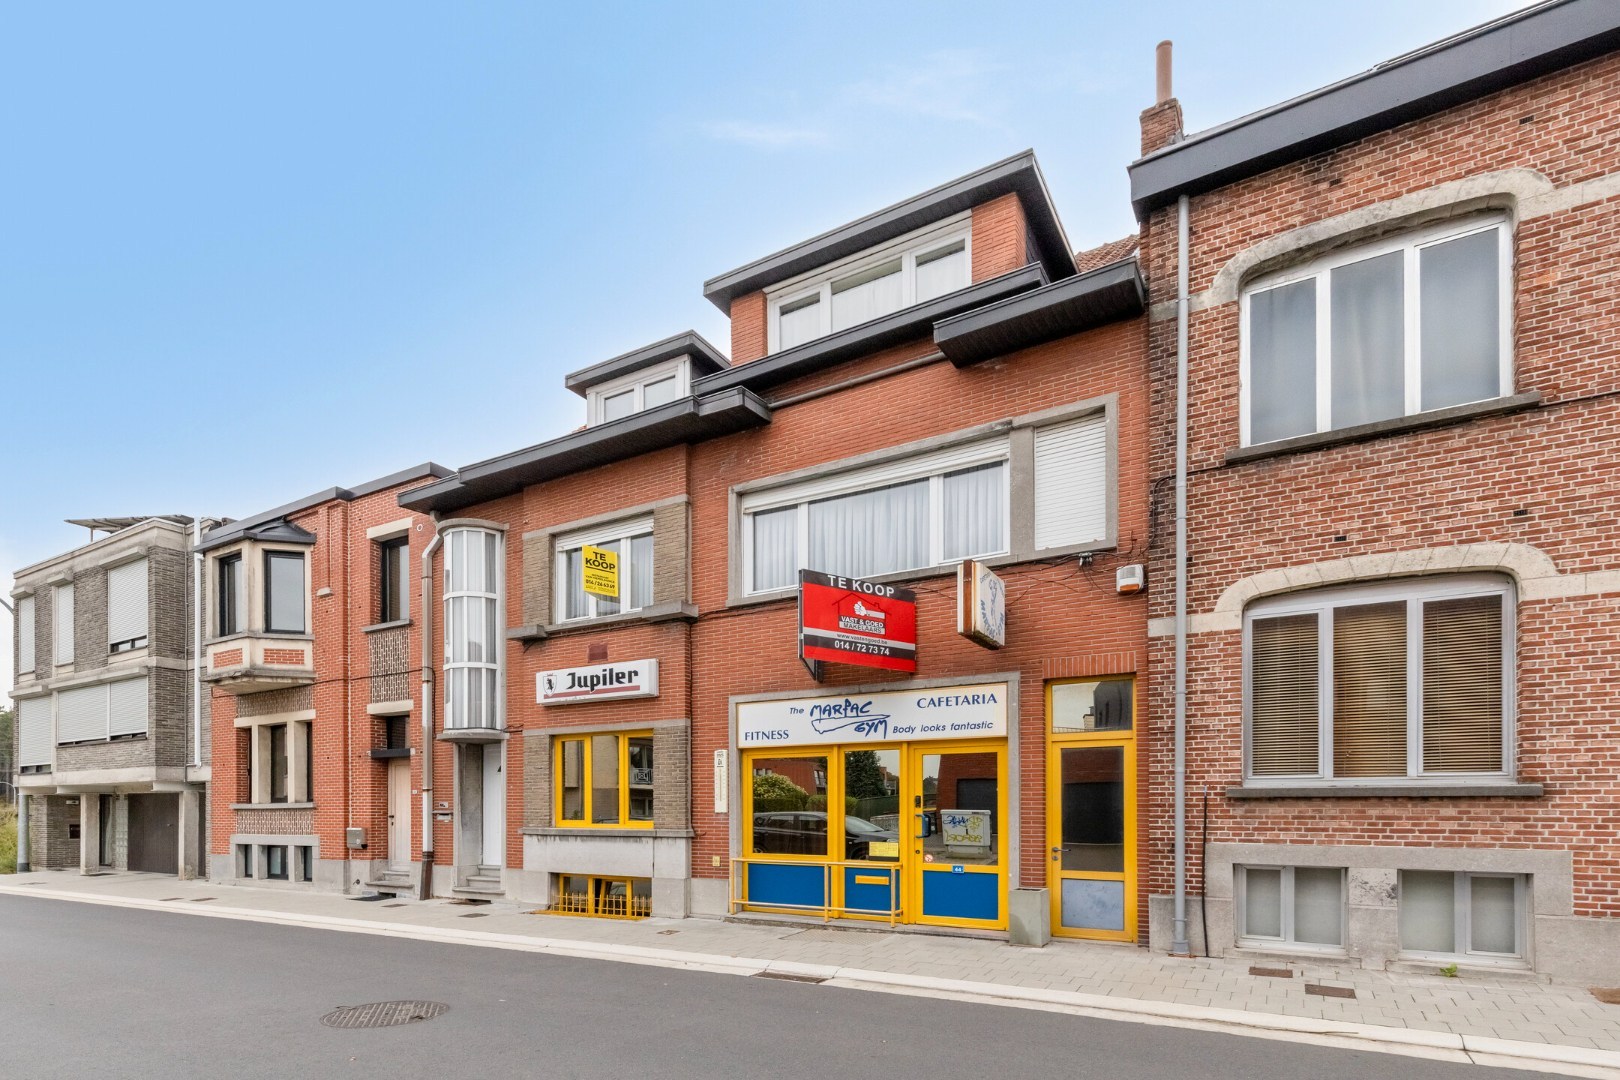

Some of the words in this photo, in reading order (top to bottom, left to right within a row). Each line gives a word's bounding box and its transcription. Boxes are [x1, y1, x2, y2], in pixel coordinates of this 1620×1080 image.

[585, 557, 616, 570] KOOP
[593, 551, 606, 562] TE
[827, 574, 847, 589] TE
[852, 579, 895, 597] KOOP
[841, 616, 859, 625] VAST
[865, 619, 884, 628] GOED
[843, 622, 882, 634] MAKELAARS
[834, 640, 850, 651] 014
[856, 643, 867, 653] 72
[868, 645, 879, 654] 73
[880, 647, 890, 656] 74
[566, 667, 639, 692] Jupiler
[916, 693, 998, 709] CAFETARIA
[854, 719, 888, 739] GYM
[892, 725, 916, 734] Body
[920, 723, 946, 732] looks
[950, 720, 994, 731] fantastic
[744, 729, 789, 741] FITNESS
